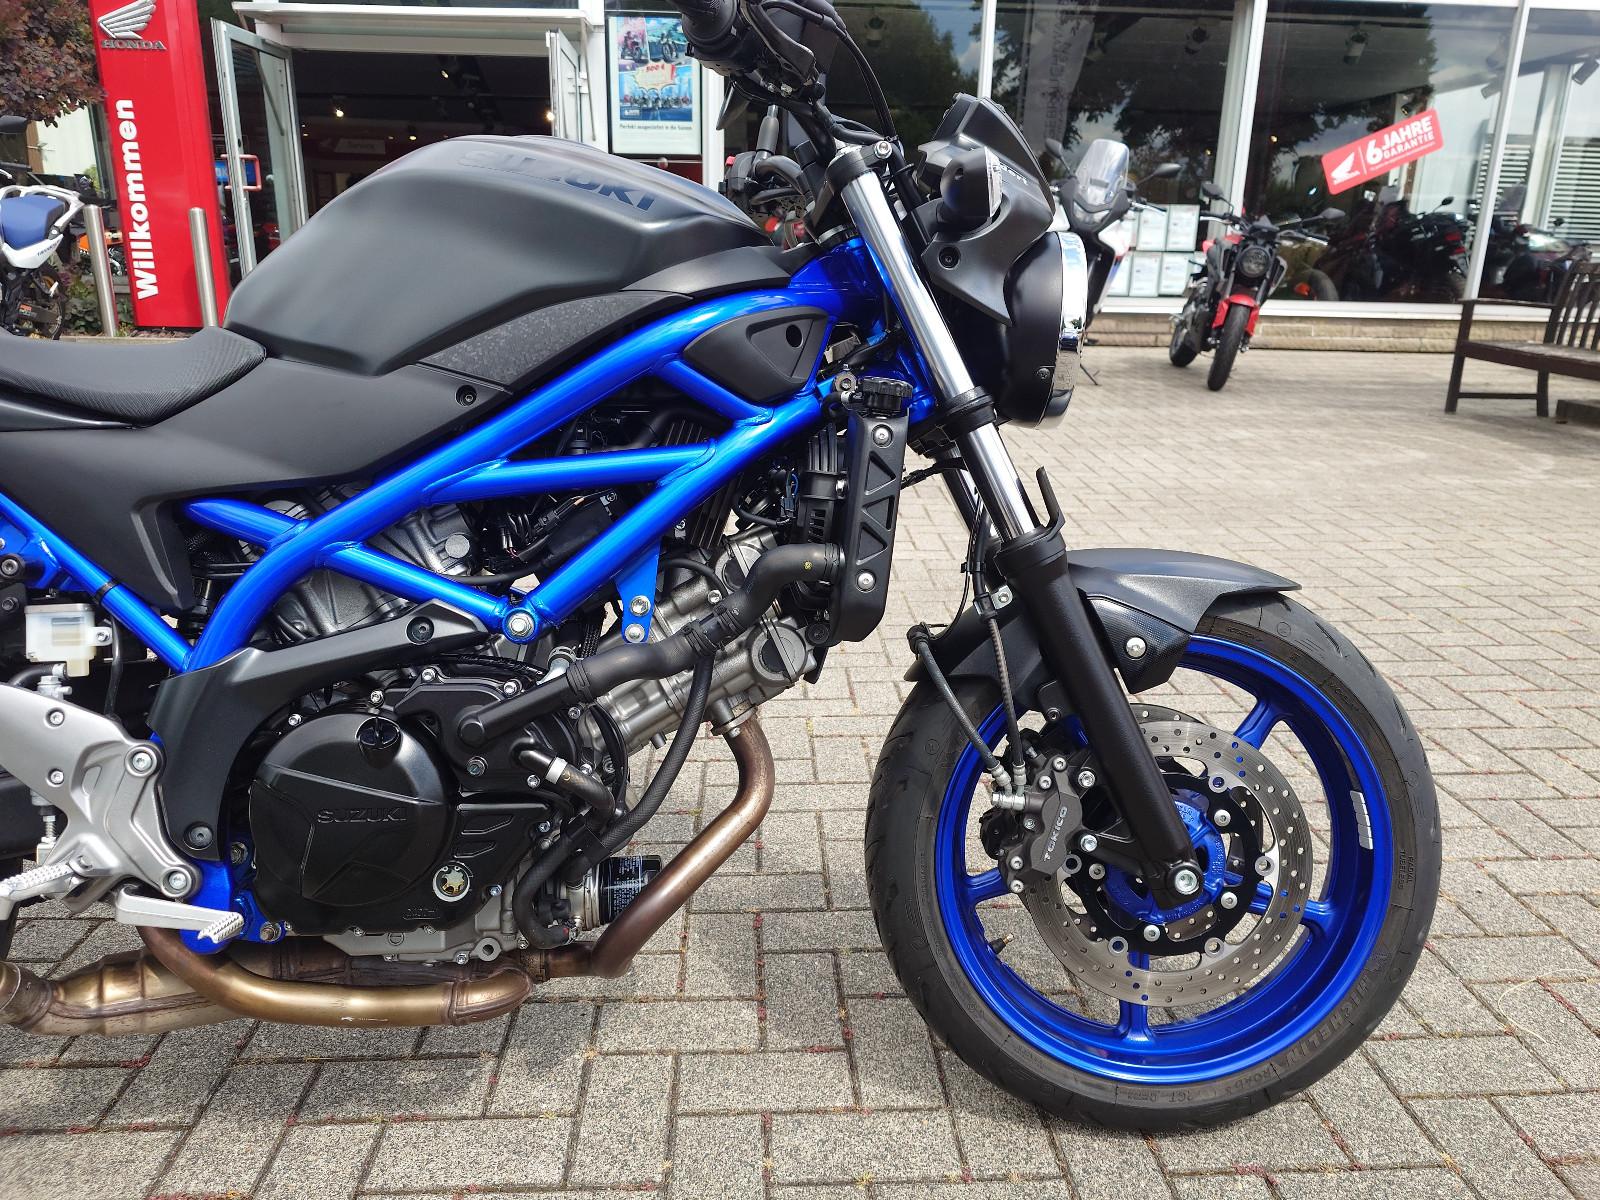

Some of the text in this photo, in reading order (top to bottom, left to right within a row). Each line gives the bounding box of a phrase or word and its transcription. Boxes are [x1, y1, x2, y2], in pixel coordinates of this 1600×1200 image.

[101, 38, 168, 50] HONDA
[1366, 138, 1383, 165] 6
[1382, 115, 1433, 151] JAHRE
[1383, 131, 1435, 160] GARANTIE
[115, 99, 159, 300] Willkommen
[318, 808, 408, 824] SUZUKI
[1043, 806, 1068, 862] TOKICO
